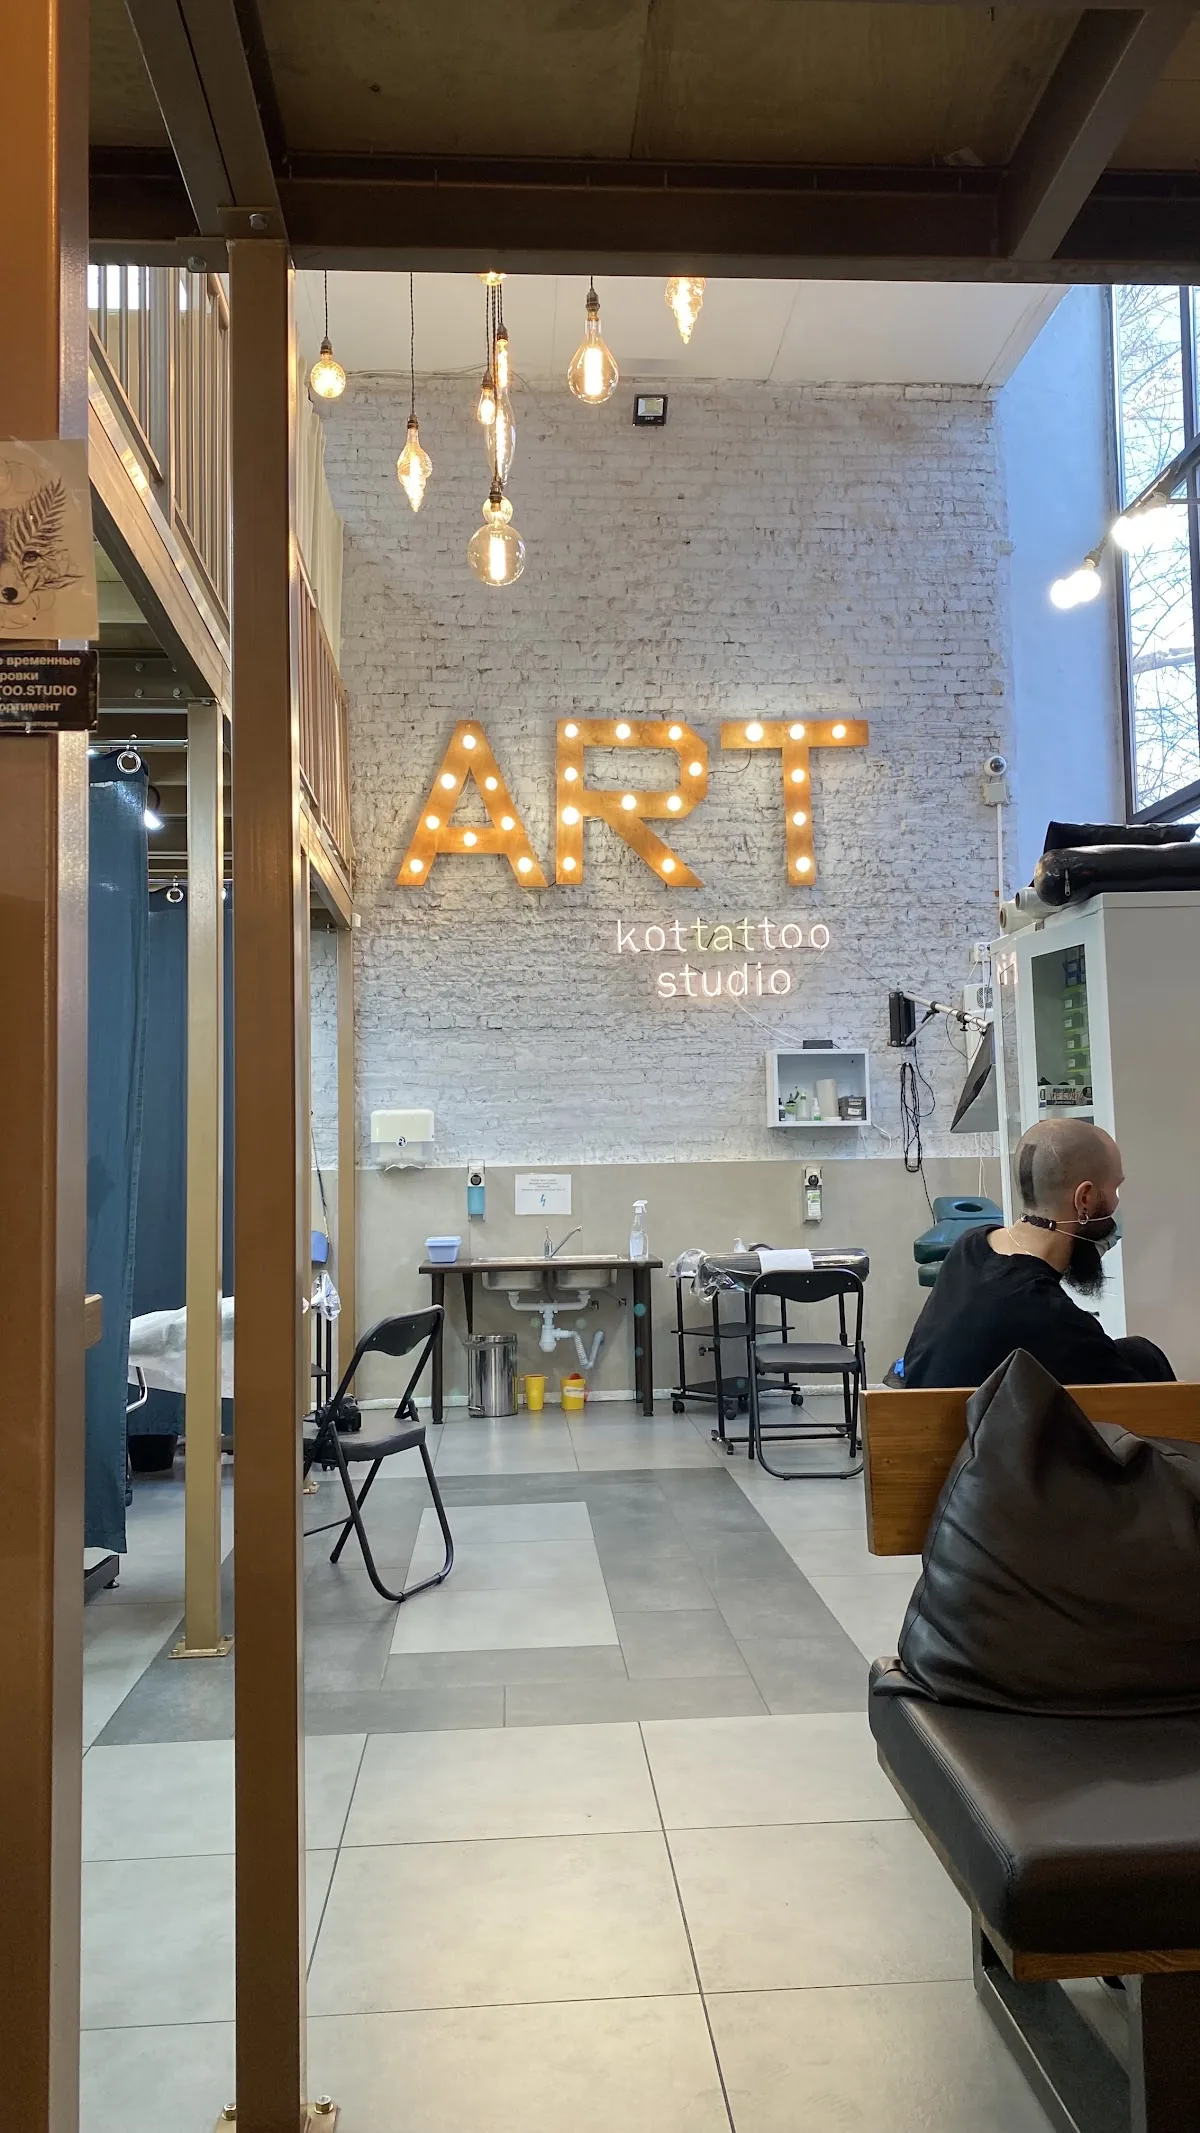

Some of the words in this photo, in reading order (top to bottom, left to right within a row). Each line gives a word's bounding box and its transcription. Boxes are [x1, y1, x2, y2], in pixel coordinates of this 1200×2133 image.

[6, 656, 81, 667] временные
[396, 719, 870, 888] ART
[616, 916, 831, 953] kottattoo
[656, 961, 792, 998] studio
